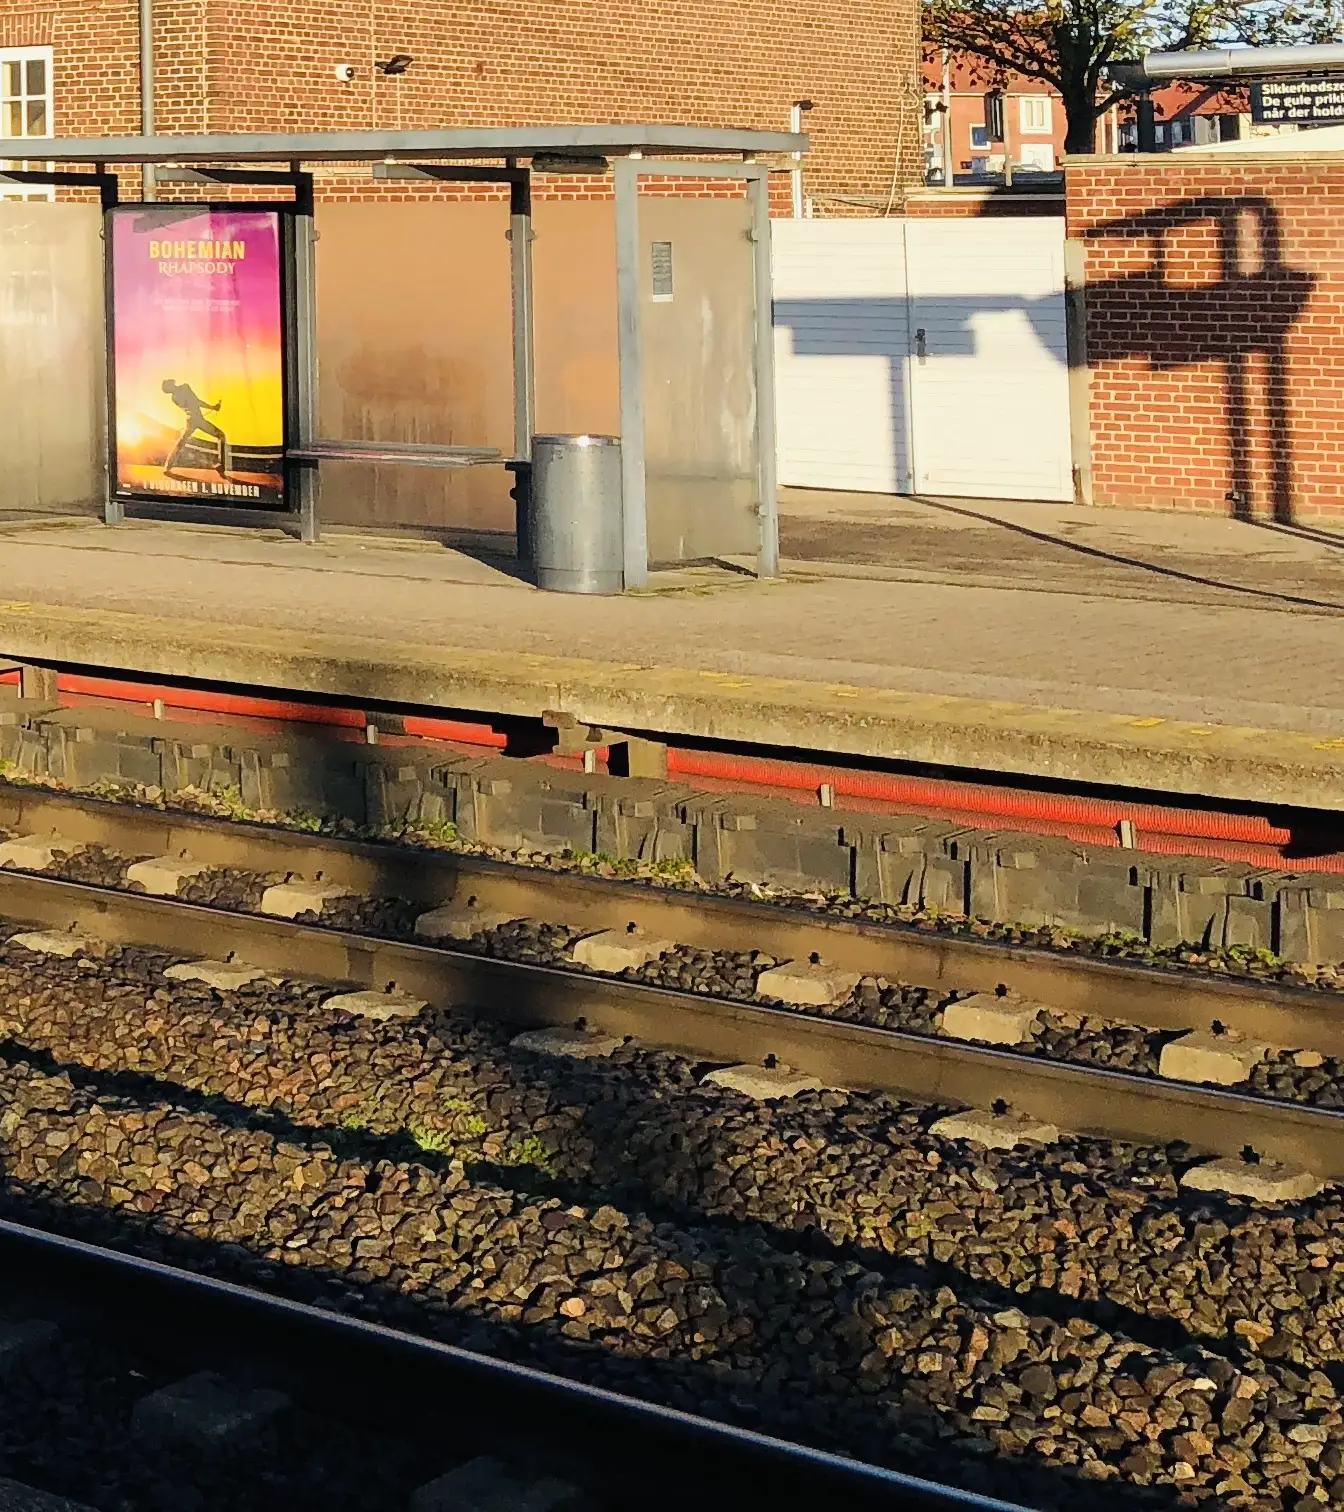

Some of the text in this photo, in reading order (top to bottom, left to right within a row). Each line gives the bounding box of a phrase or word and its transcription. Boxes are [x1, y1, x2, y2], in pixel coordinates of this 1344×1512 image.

[1262, 96, 1280, 107] De
[1283, 94, 1312, 108] gule
[1263, 105, 1344, 119] når der hold
[149, 240, 246, 260] BOHEMIAN
[158, 261, 236, 278] RHAPSODY
[211, 484, 260, 498] NOVEMBER
